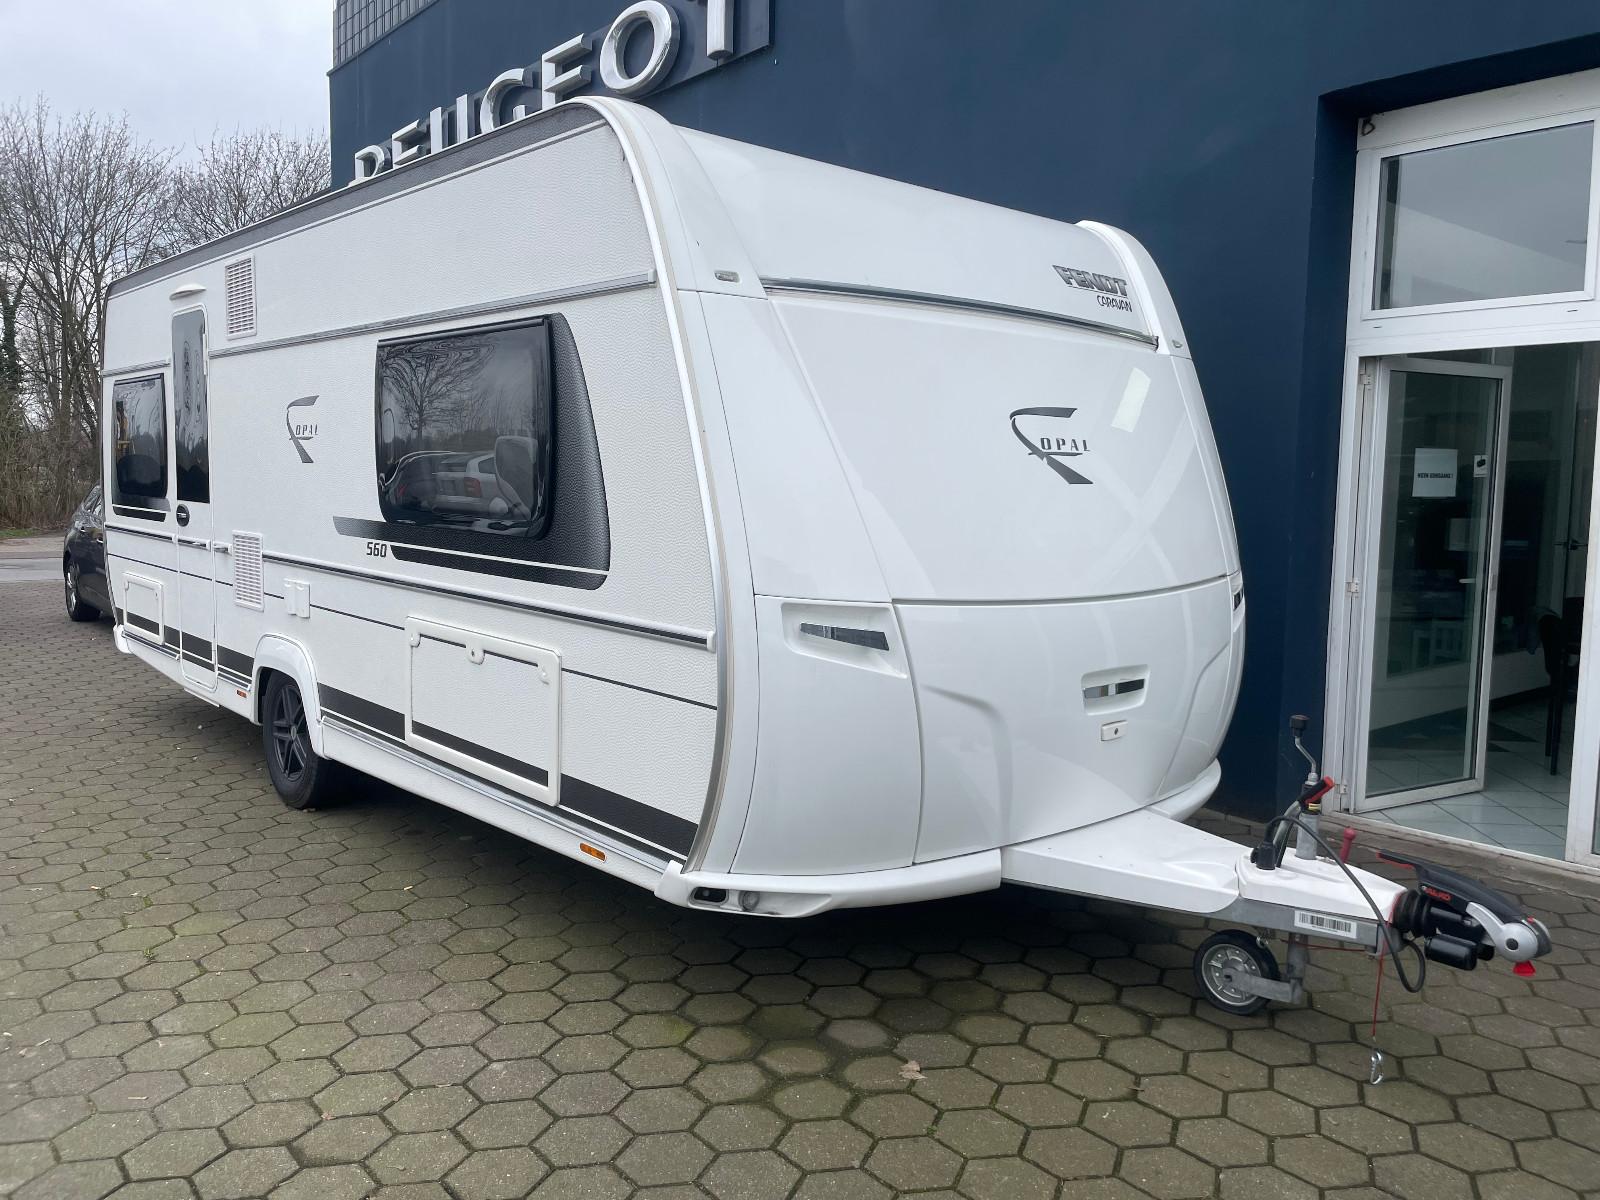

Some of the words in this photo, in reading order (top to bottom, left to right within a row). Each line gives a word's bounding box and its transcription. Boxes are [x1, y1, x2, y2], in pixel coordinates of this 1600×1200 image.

[1053, 265, 1128, 298] FENDT
[1096, 294, 1133, 313] CARAVAN
[295, 424, 319, 436] OPAL
[1040, 437, 1091, 452] OPAL
[366, 541, 388, 558] 560
